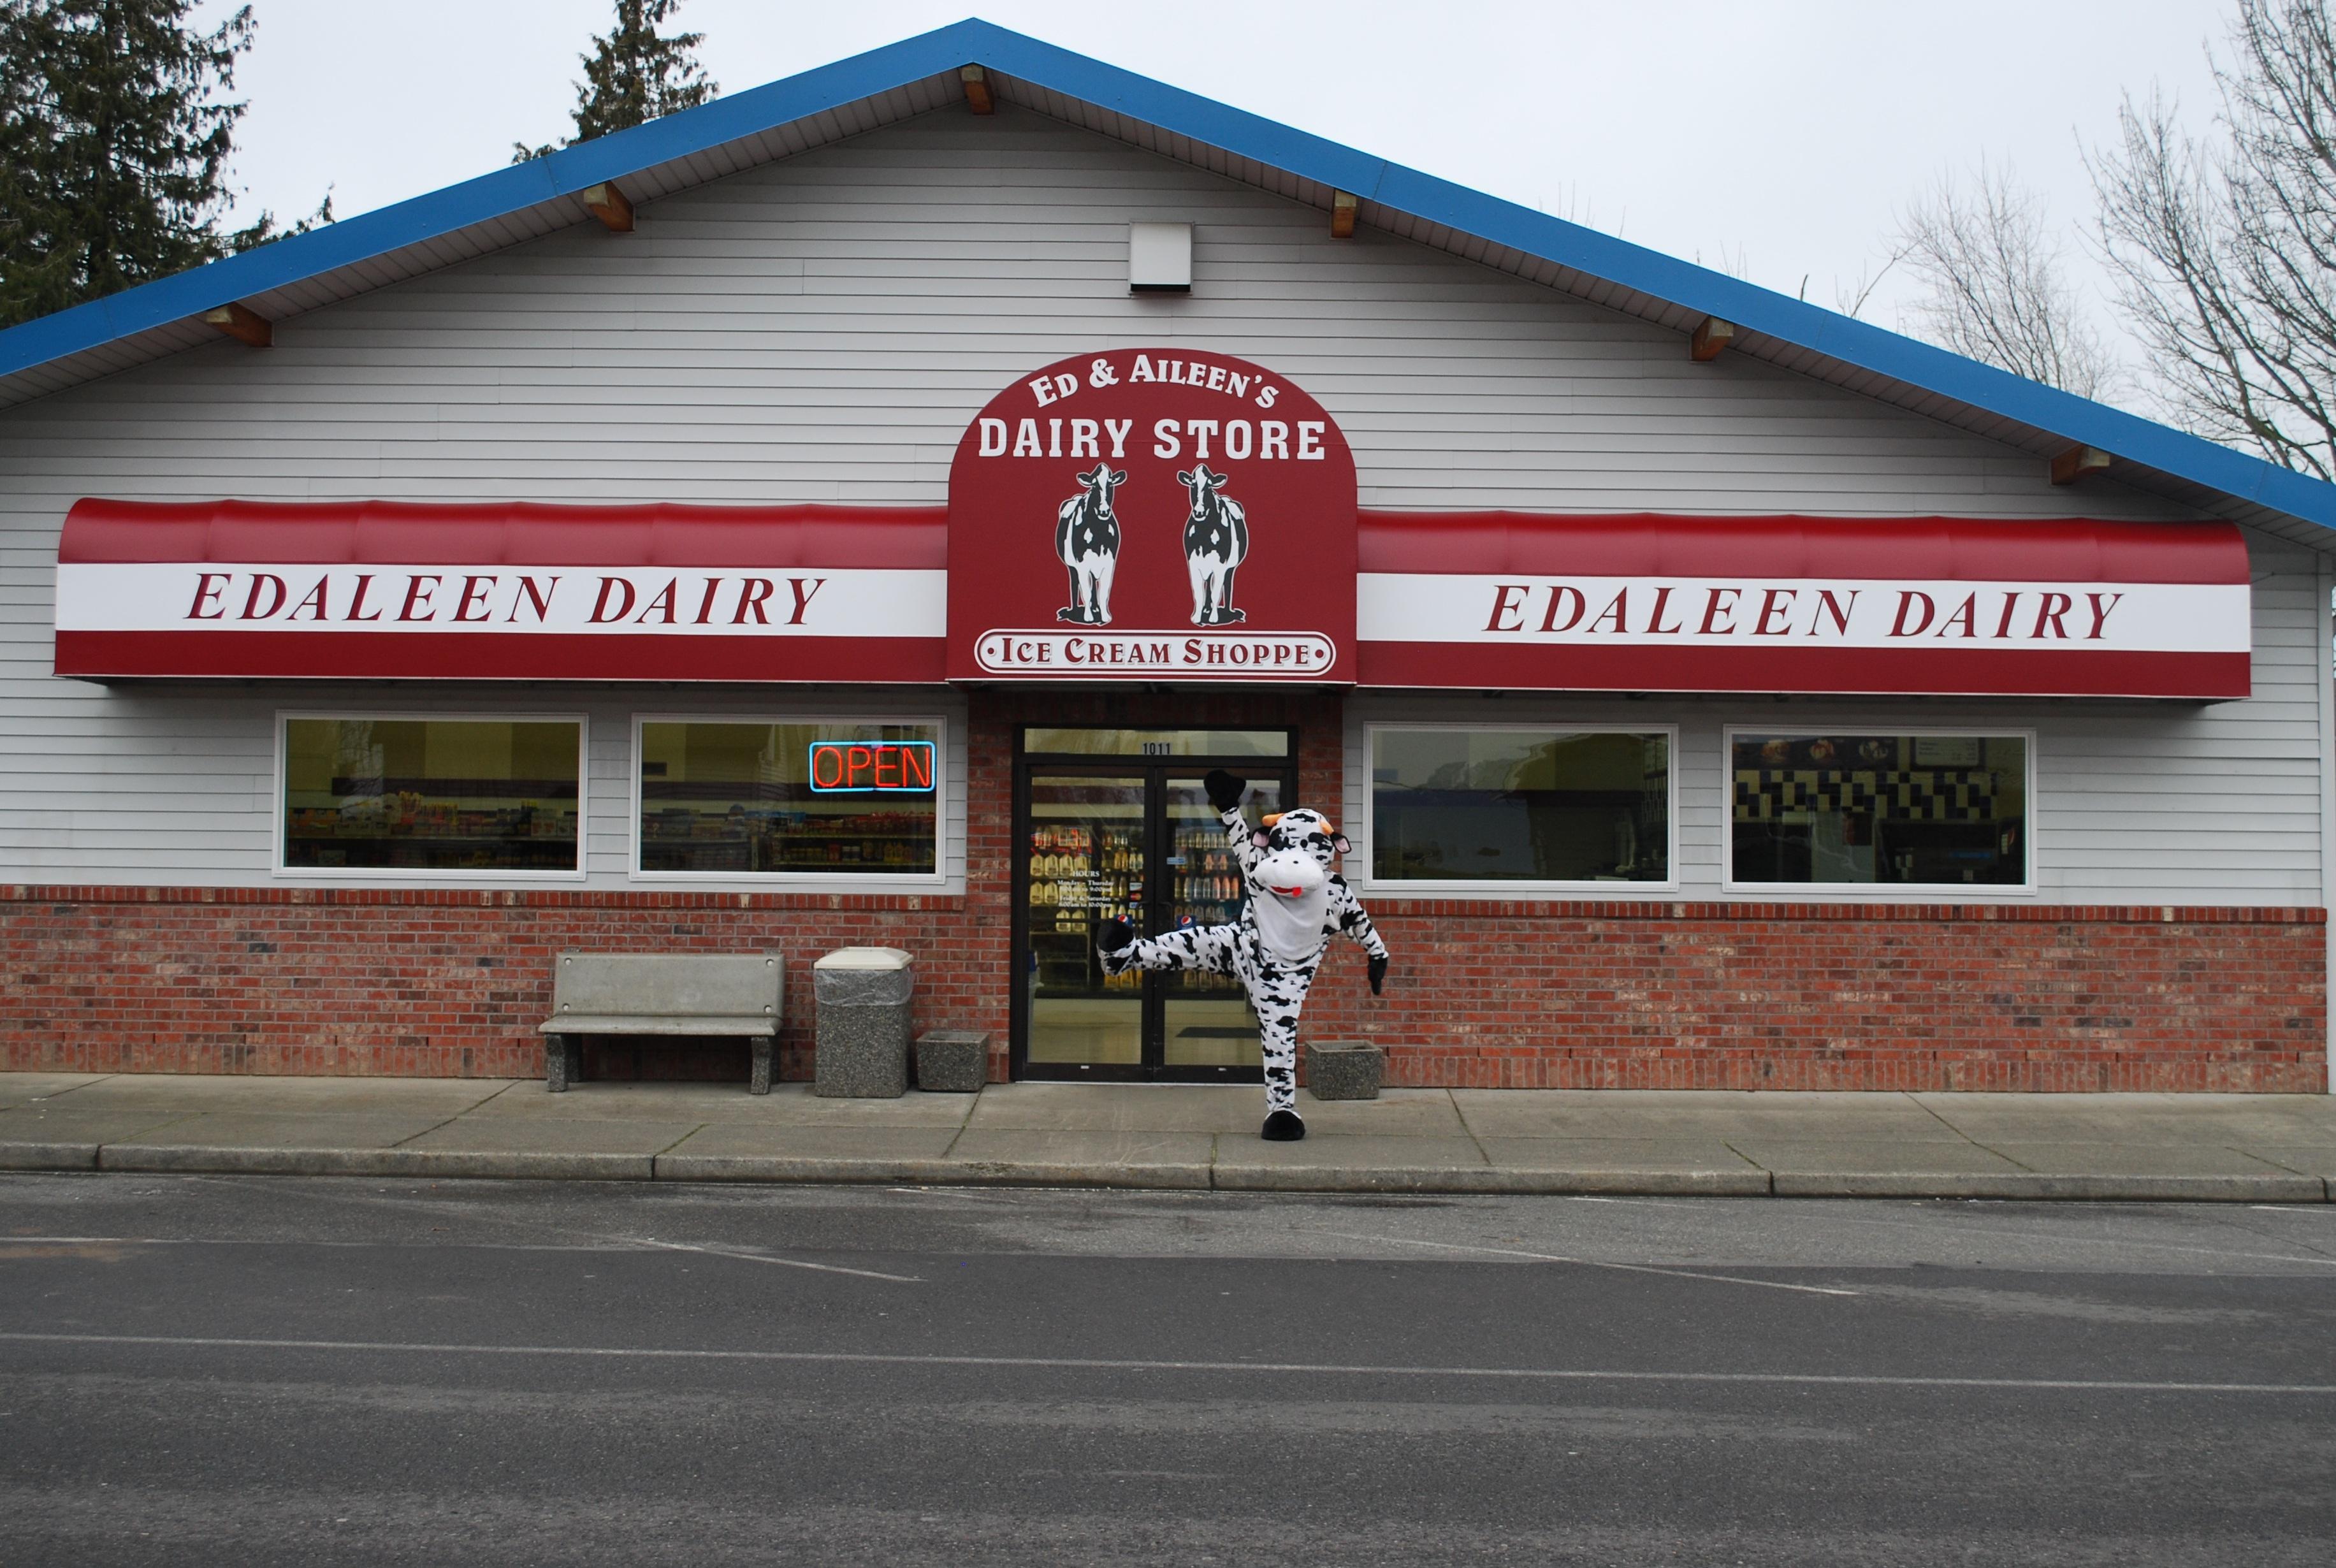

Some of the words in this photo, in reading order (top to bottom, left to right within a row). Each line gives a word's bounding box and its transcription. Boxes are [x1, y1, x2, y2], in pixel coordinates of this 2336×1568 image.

[1029, 374, 1078, 407] ED
[1089, 359, 1119, 388] &
[1129, 355, 1279, 408] AILEEN'S
[979, 418, 1132, 457] DAIRY
[1154, 419, 1324, 460] STORE
[184, 574, 561, 622] EDALEEN
[585, 577, 826, 624] DAIRY
[1481, 585, 1861, 636] EDALEEN
[1886, 592, 2123, 639] DAIRY
[1001, 637, 1052, 663] ICE
[1064, 637, 1171, 664] CREAM
[1184, 639, 1309, 665] SHOPPE
[813, 746, 931, 788] OPEN
[1143, 742, 1170, 755] 1011
